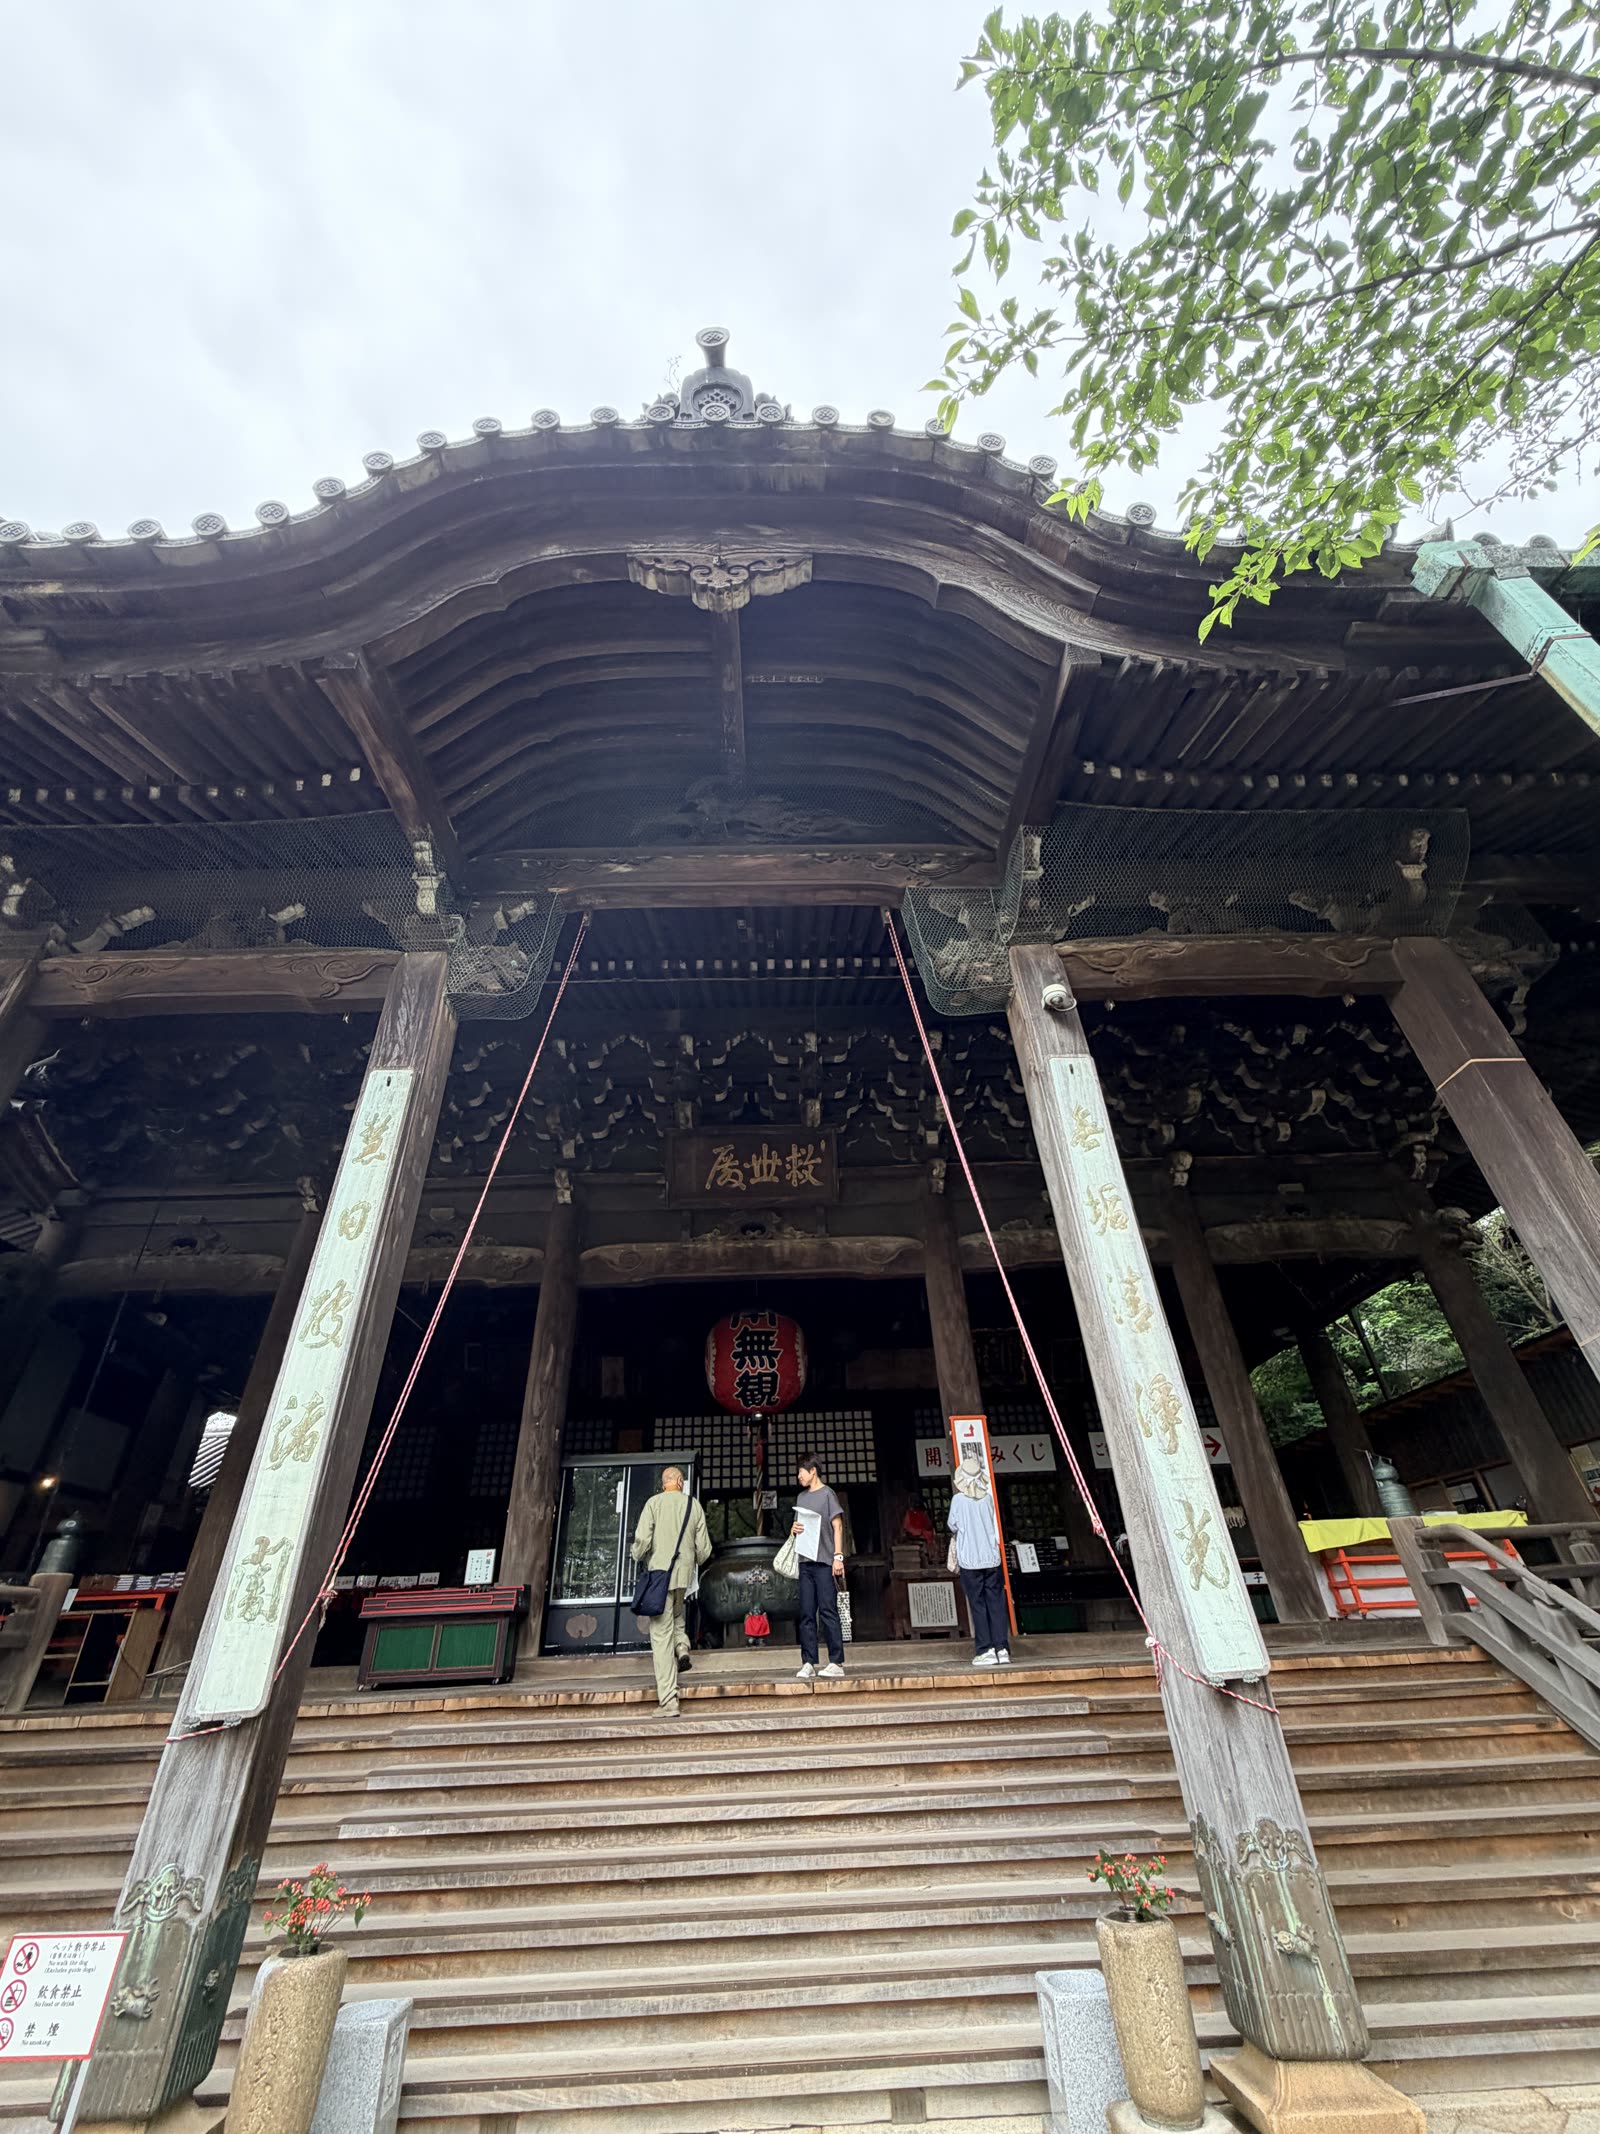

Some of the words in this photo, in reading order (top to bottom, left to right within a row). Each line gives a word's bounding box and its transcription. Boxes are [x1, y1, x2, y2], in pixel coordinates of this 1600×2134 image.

[52, 1941, 106, 1952] ペット散歩禁止
[37, 1984, 82, 1999] 飲食禁止
